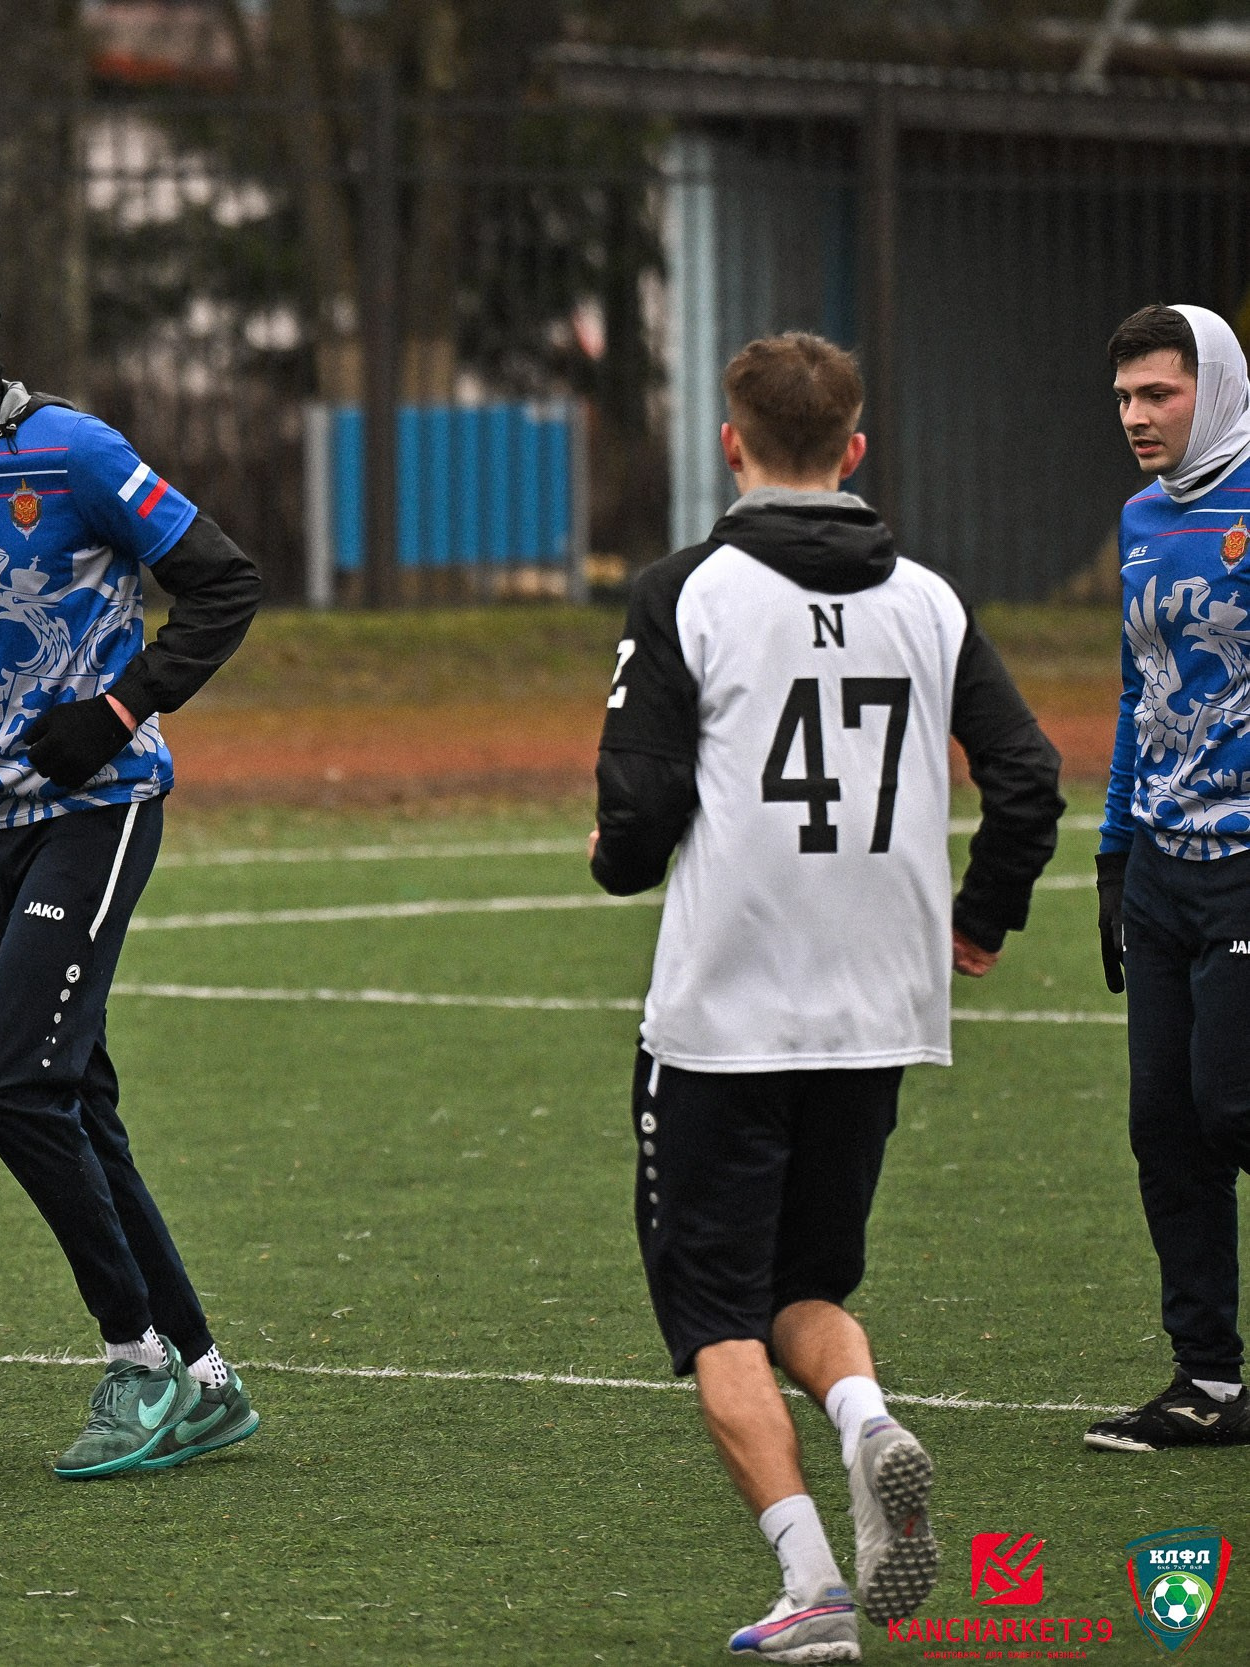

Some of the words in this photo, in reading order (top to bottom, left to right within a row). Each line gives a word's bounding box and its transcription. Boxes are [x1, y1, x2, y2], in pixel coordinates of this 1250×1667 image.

[808, 603, 845, 649] N
[761, 677, 912, 854] 47
[24, 901, 65, 920] JAKO
[1229, 940, 1250, 955] JA
